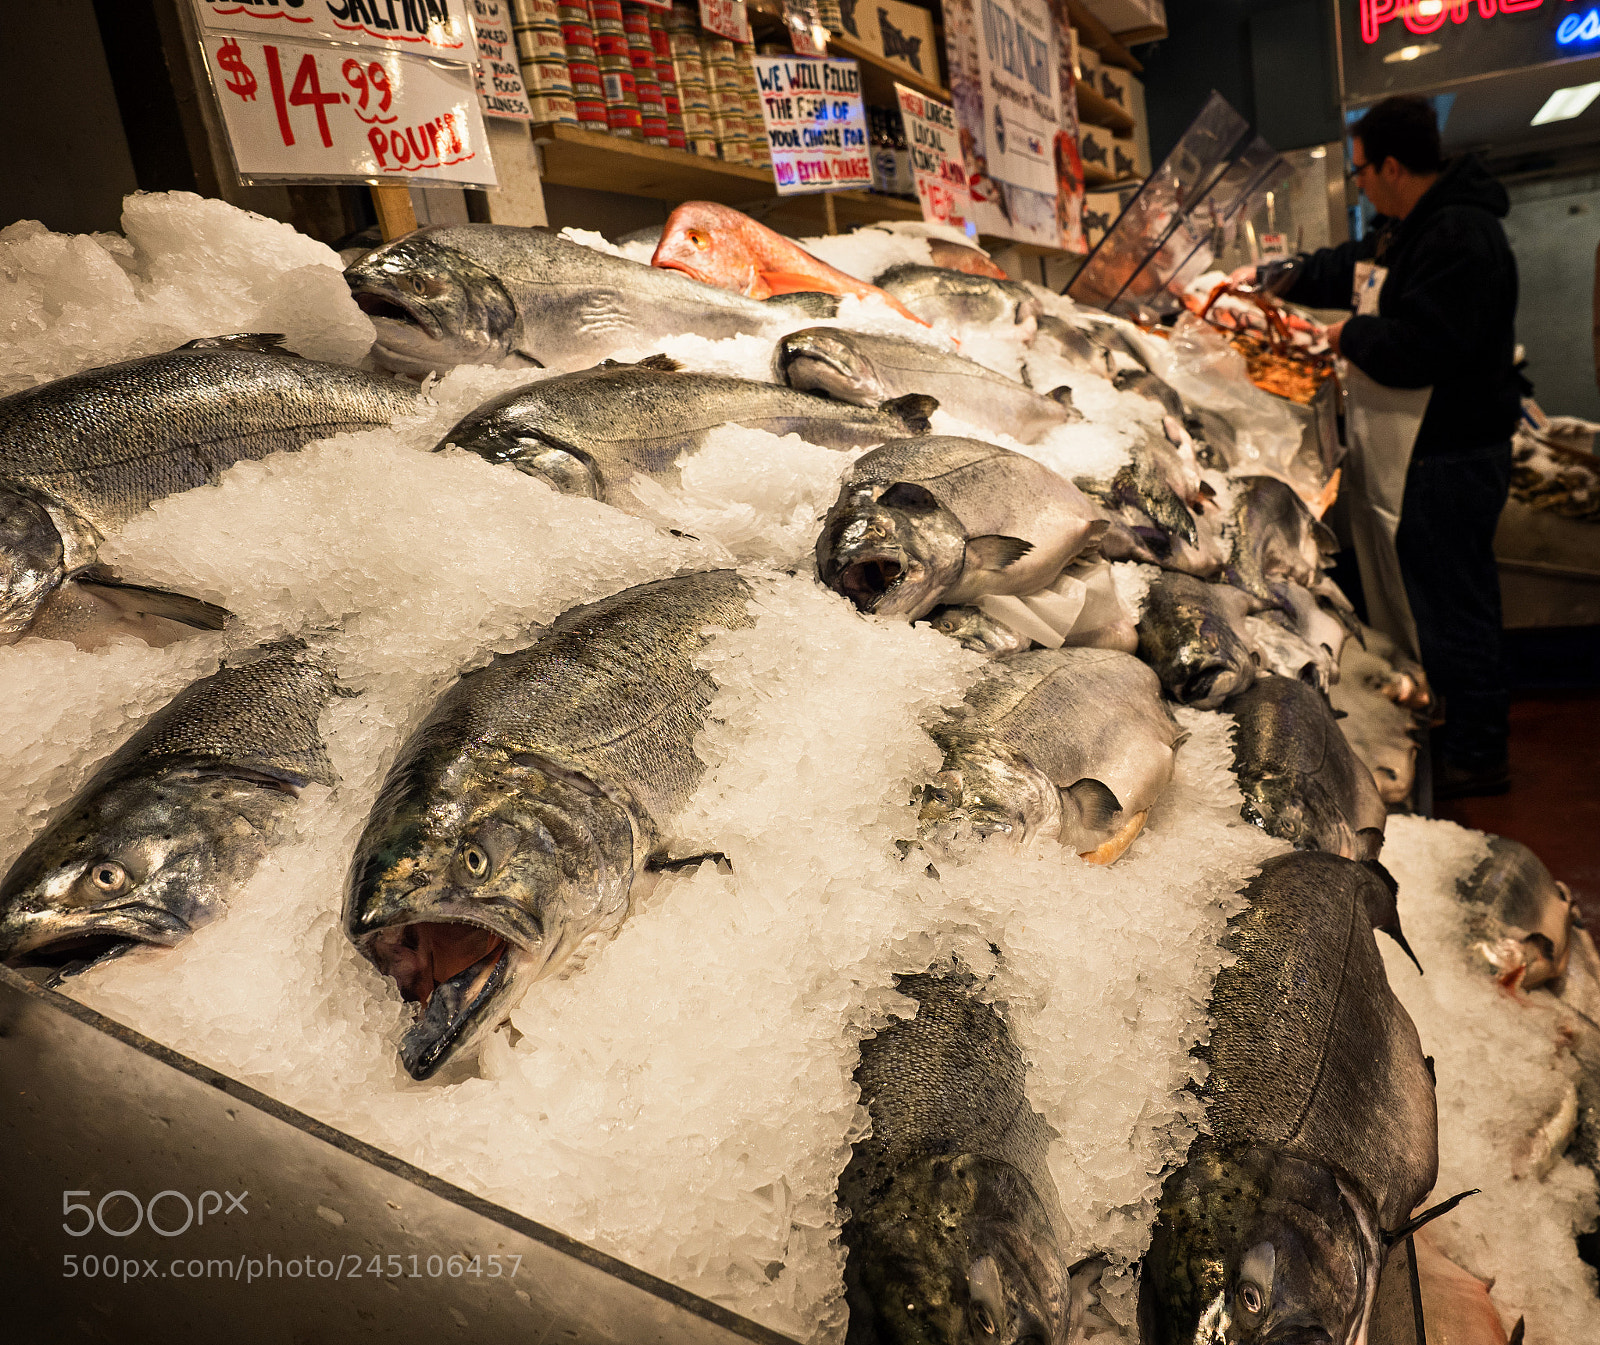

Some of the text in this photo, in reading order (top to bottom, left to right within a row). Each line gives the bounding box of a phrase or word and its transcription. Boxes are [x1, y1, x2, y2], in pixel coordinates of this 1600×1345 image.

[757, 63, 859, 92] WE WILL FILLET
[765, 98, 793, 119] THE
[832, 101, 850, 120] OF
[769, 129, 802, 147] YOUR
[843, 128, 865, 146] FOR
[912, 119, 946, 152] LOCAL
[775, 160, 794, 182] NO
[797, 160, 833, 181] EXTRA
[832, 157, 871, 178] CHARGE
